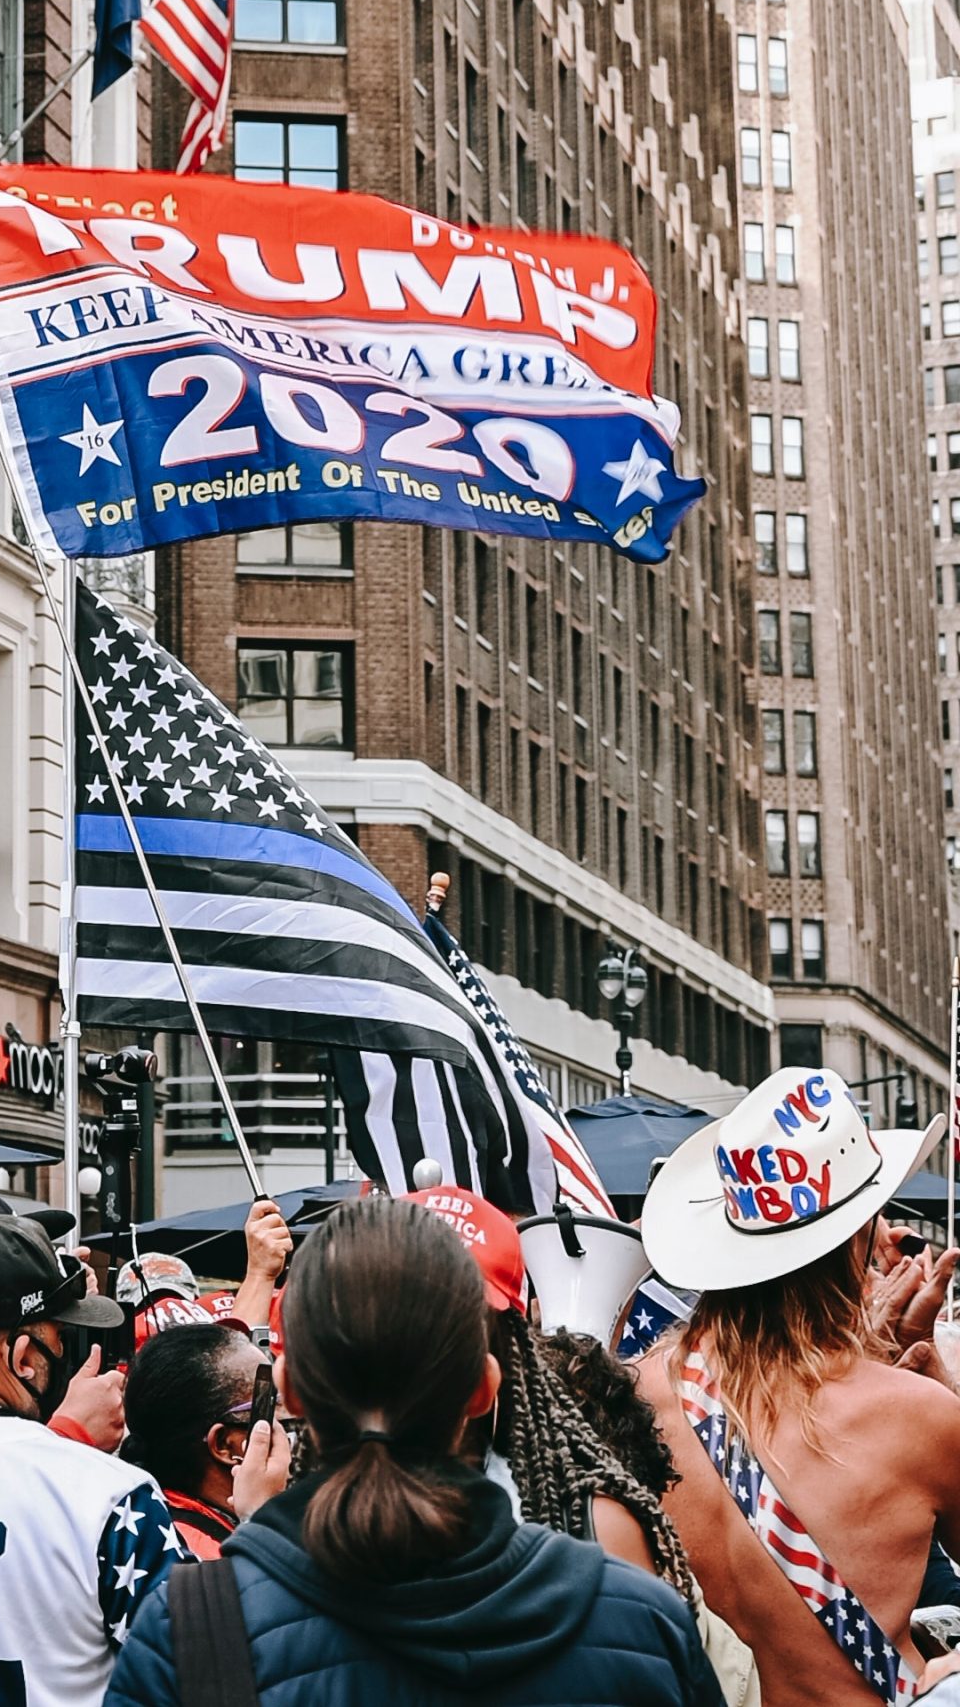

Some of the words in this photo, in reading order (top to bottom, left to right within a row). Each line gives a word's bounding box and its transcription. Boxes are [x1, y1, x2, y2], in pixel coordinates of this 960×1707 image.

[191, 308, 438, 384] AMERICA
[451, 345, 620, 394] GRE
[147, 354, 577, 503] 2020
[76, 496, 138, 529] For
[151, 460, 302, 514] President
[320, 458, 364, 489] Of
[376, 468, 442, 503] The
[456, 480, 561, 524] United
[773, 1075, 832, 1138] NYC
[425, 1195, 474, 1217] KEEP
